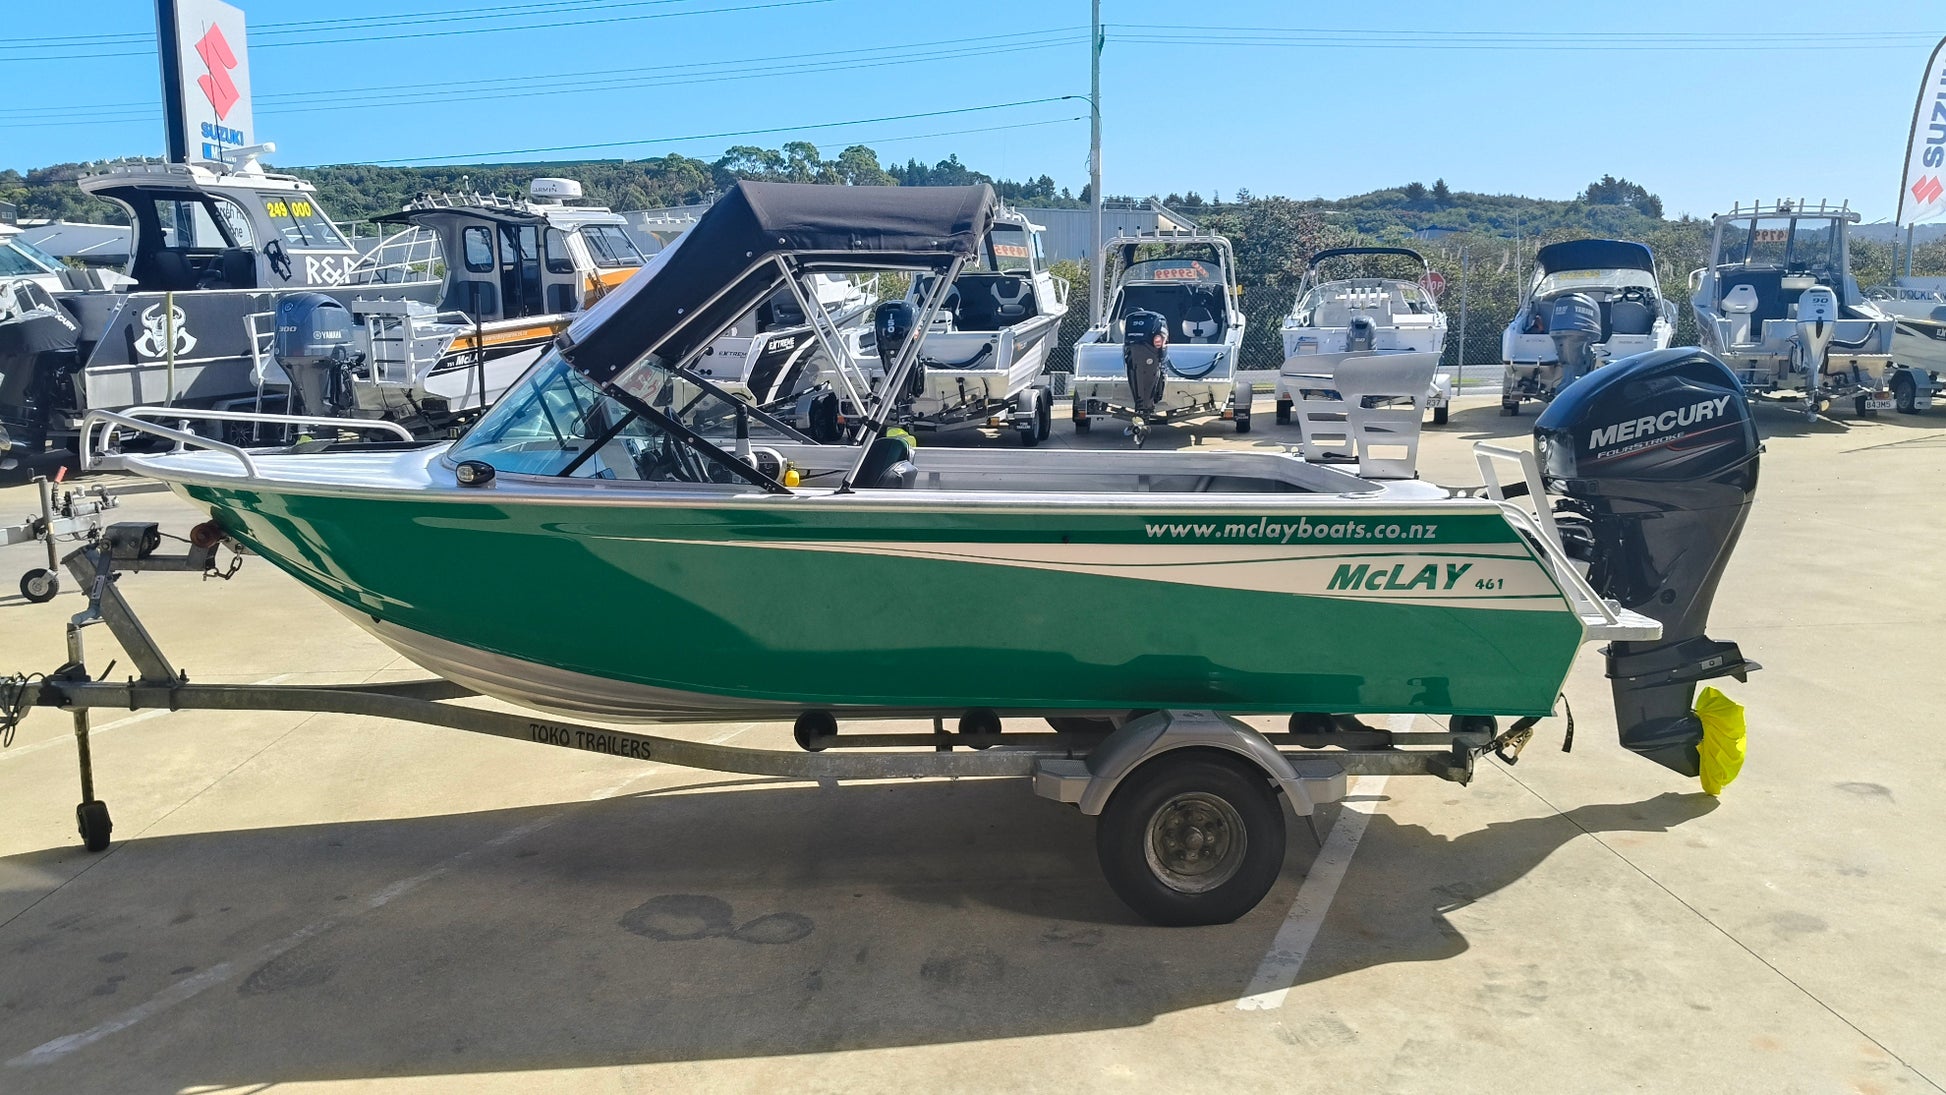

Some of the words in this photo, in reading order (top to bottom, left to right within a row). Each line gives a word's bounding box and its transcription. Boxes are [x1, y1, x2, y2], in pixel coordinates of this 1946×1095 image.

[201, 121, 244, 147] SUZUKI
[266, 202, 287, 218] 249
[291, 202, 312, 218] 000
[1420, 280, 1443, 290] STOP
[1900, 289, 1946, 300] DOCKL
[768, 336, 795, 350] EXTREME
[1588, 395, 1731, 450] MERCURY
[1597, 431, 1686, 459] FOURSTROKE
[1144, 517, 1438, 544] www.mclayboats.co.nz
[1326, 563, 1474, 592] McLAY
[1474, 577, 1504, 591] 461
[529, 723, 570, 748] TOKO
[575, 731, 652, 761] TRAILERS
